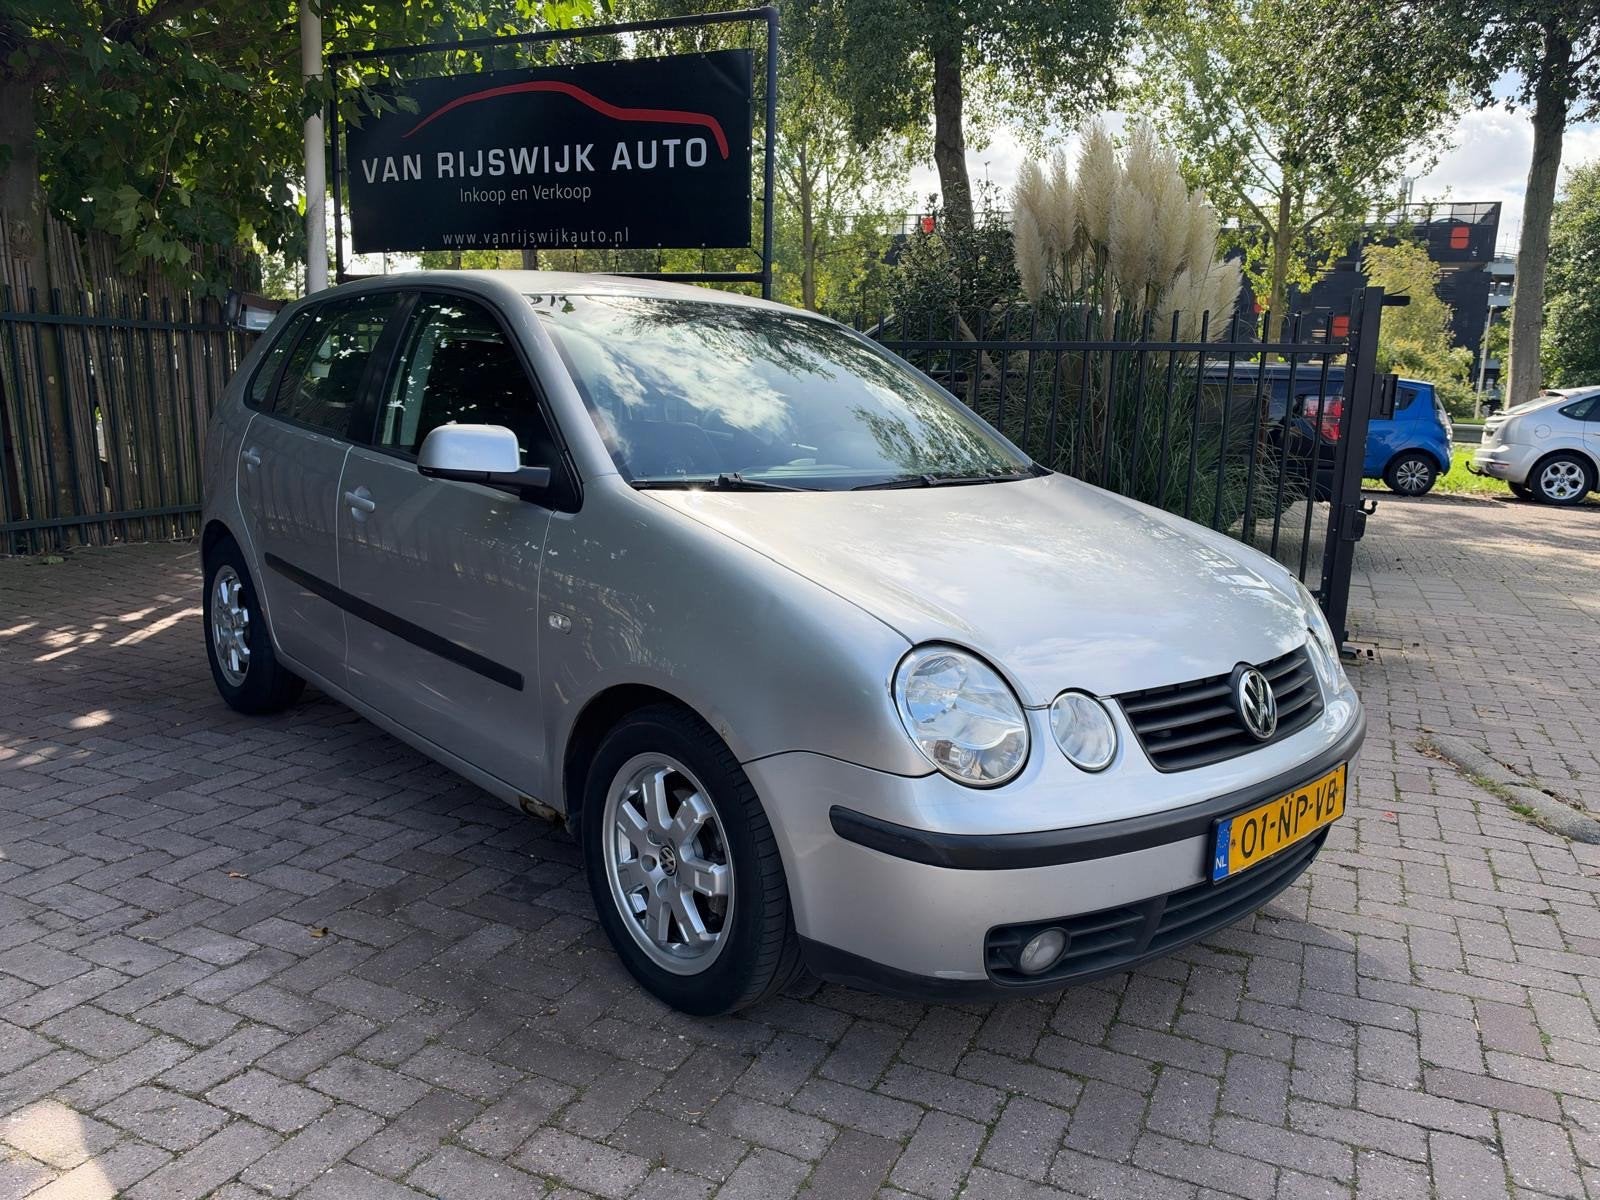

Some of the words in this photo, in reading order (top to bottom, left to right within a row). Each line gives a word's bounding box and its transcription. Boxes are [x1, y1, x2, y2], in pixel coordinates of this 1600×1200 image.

[361, 154, 422, 184] VAN
[436, 143, 596, 178] RIJSWIJK
[611, 137, 708, 171] AUTO
[460, 187, 507, 205] Inkoop
[511, 189, 528, 201] en
[532, 184, 592, 202] Verkoop
[443, 227, 630, 247] www.vanrijswijkauto.nl
[1241, 778, 1337, 858] 01-NP-VB
[1215, 858, 1227, 870] NL
